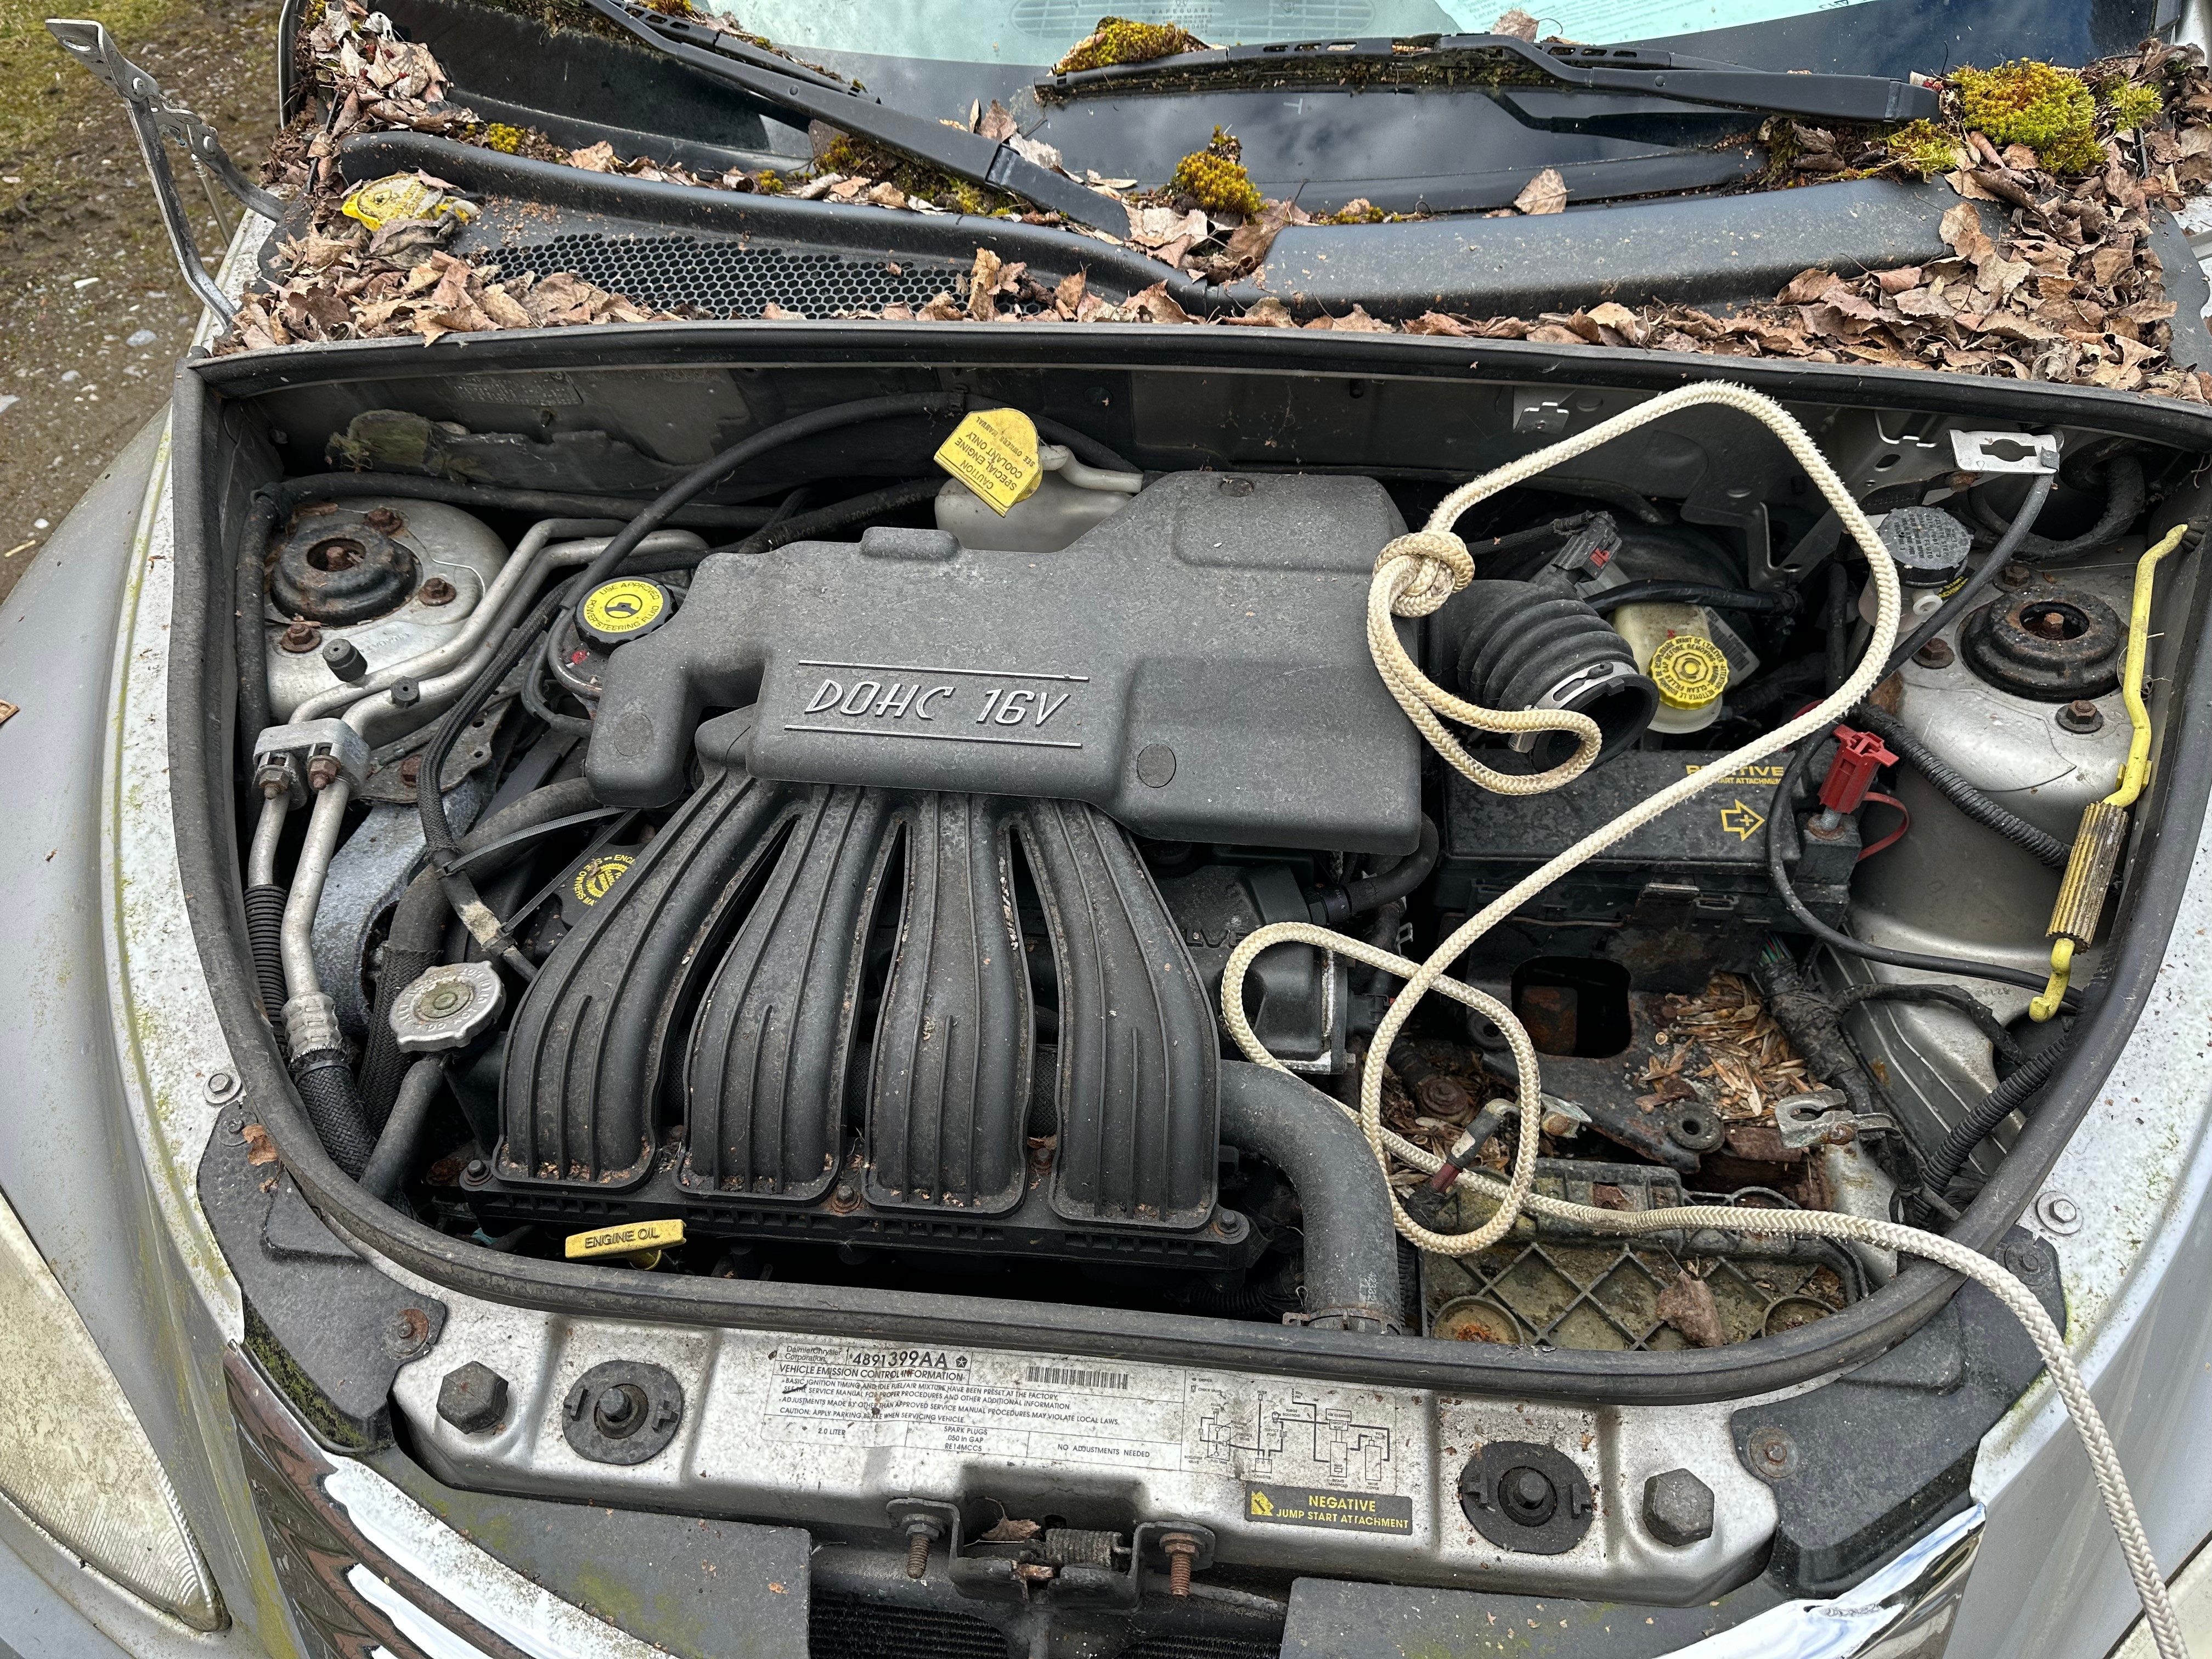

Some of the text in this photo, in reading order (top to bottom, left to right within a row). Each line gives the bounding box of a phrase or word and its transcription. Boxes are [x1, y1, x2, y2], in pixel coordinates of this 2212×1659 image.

[975, 416, 998, 437] MANUAL
[955, 437, 1017, 491] SPECIAL ENGINE
[966, 431, 1023, 479] COOLANT ONLY
[1023, 455, 1035, 467] SEE
[960, 460, 994, 489] CAUTION
[1923, 539, 1933, 559] FLUID
[599, 582, 660, 600] USE APPROVED
[586, 599, 659, 631] POWER STEERING FLUID
[1664, 644, 1684, 659] BEFORE
[1687, 644, 1716, 662] REMOVING
[1666, 674, 1684, 691] FILLER
[1686, 684, 1708, 693] CLEAN
[804, 679, 1071, 727] DOHC 16V
[1689, 689, 1715, 701] NETTOYER
[1686, 765, 1784, 776] PITIVE
[574, 871, 587, 900] OWNERS
[585, 1227, 660, 1249] ENGINE OIL
[785, 1353, 826, 1362] Corporation
[786, 1345, 842, 1357] DaimlerChrysler
[852, 1351, 949, 1369] 4891399AA
[780, 1363, 964, 1382] VEHICLE EMISSION CONTROL INFORMATION
[785, 1377, 805, 1385] BASIC
[806, 1379, 836, 1387] IGNITION
[837, 1380, 861, 1389] TIMING
[891, 1383, 917, 1391] FUEL/AIR
[918, 1384, 946, 1392] MIXTURE
[984, 1388, 1005, 1396] PRESET
[1029, 1391, 1058, 1401] FACTORY,
[809, 1387, 834, 1396] SERVICE
[836, 1389, 864, 1398] MANUAL
[900, 1391, 943, 1400] PROCEDURES
[960, 1395, 981, 1403] OTHER
[982, 1396, 1023, 1406] ADDITIONAL
[1023, 1399, 1071, 1410] INFORMATION.
[780, 1407, 811, 1415] CAUTION:
[812, 1408, 832, 1417] APPLY
[833, 1409, 862, 1419] PARKING
[884, 1412, 900, 1420] WHEN
[900, 1412, 936, 1422] SERVICING
[937, 1414, 966, 1424] VEHICLE.
[781, 1396, 826, 1406] ADJUSTMENTS
[827, 1399, 846, 1407] MADE
[858, 1401, 878, 1409] OTHER
[894, 1401, 928, 1410] APPROVED
[929, 1402, 956, 1412] SERVICE
[958, 1405, 986, 1414] MANUAL
[988, 1407, 1030, 1418] PROCEDURES
[1048, 1413, 1075, 1422] VIOLATE
[1076, 1415, 1099, 1424] LOCAL
[1100, 1416, 1120, 1426] LAWS.
[944, 1425, 988, 1436] SPARK PLUGS
[968, 1435, 984, 1444] GAP
[944, 1443, 982, 1452] RE14MCC5
[1073, 1444, 1120, 1455] ADJUSTMENTS
[1123, 1449, 1150, 1458] NEEDED
[1308, 1495, 1376, 1513] NEGATIVE
[1276, 1509, 1409, 1529] JUMP START ATTACHMENT
